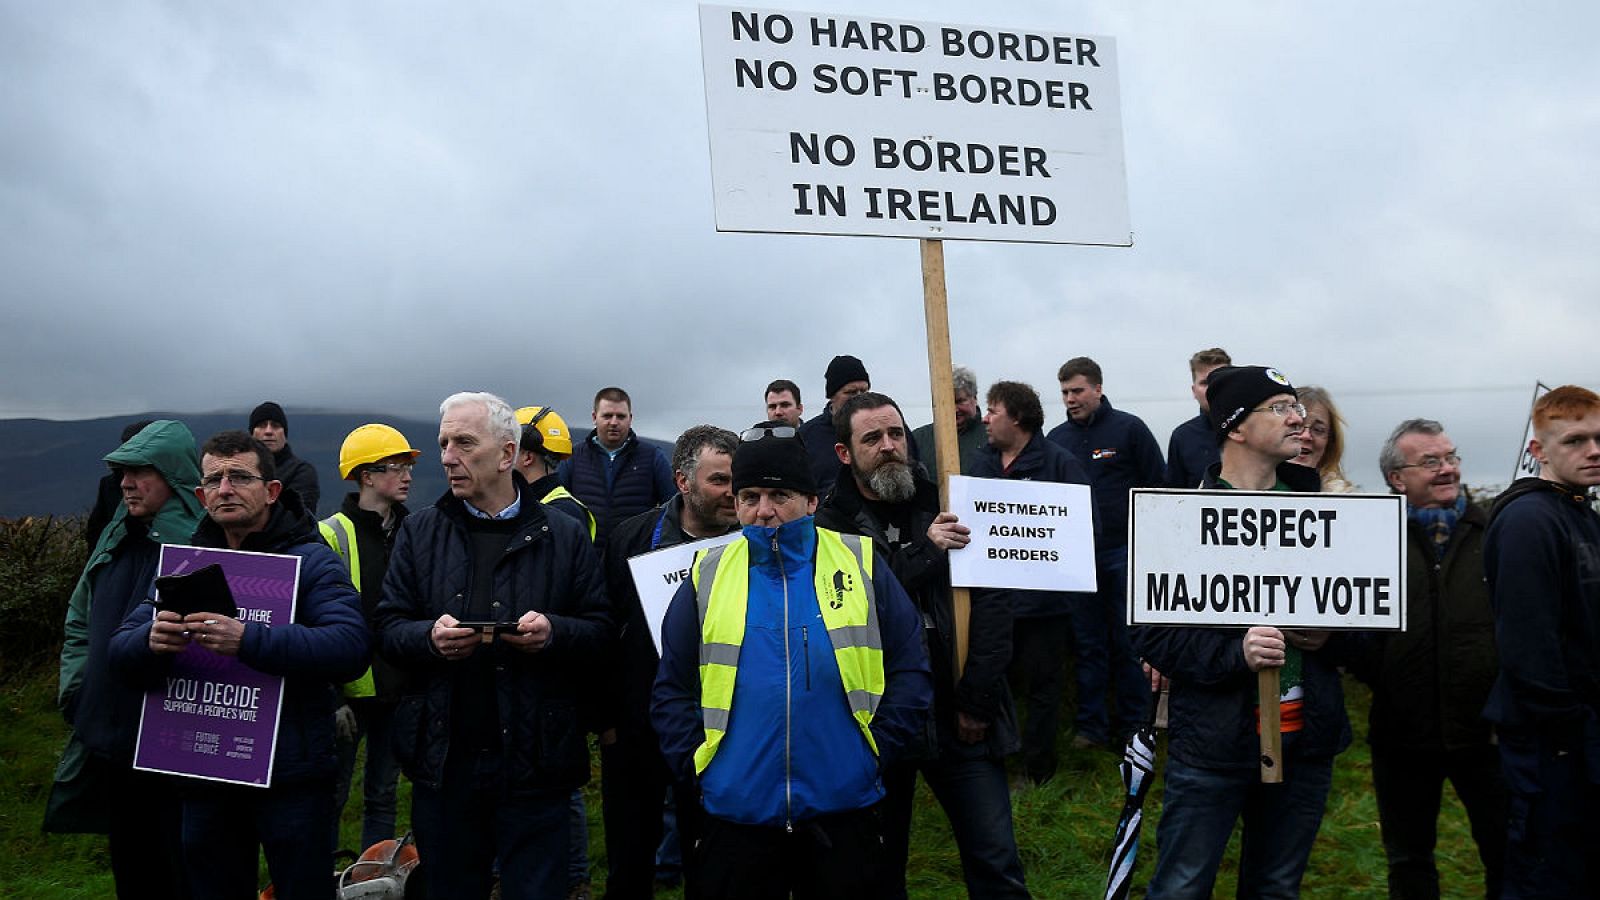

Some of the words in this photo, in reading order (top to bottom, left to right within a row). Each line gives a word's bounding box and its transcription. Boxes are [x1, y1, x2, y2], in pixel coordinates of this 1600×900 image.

[732, 11, 794, 45] NO
[810, 17, 926, 54] HARD
[940, 27, 1101, 68] BORDER
[735, 58, 797, 91] NO
[812, 63, 918, 99] SOFT
[933, 72, 1093, 111] BORDER
[790, 131, 856, 167] NO
[873, 137, 1052, 178] BORDER
[792, 183, 847, 218] IN
[863, 187, 1058, 227] IRELAND
[974, 500, 1068, 517] WESTMEATH
[988, 524, 1056, 539] AGAINST
[1201, 507, 1337, 549] RESPECT
[987, 547, 1060, 562] BORDERS
[1147, 572, 1302, 614] MAJORITY
[1311, 576, 1390, 616] VOTE
[248, 608, 273, 624] HERE
[163, 699, 198, 714] SUPPORT
[239, 709, 258, 722] VOTE
[166, 677, 199, 701] YOU
[202, 682, 261, 709] DECIDE
